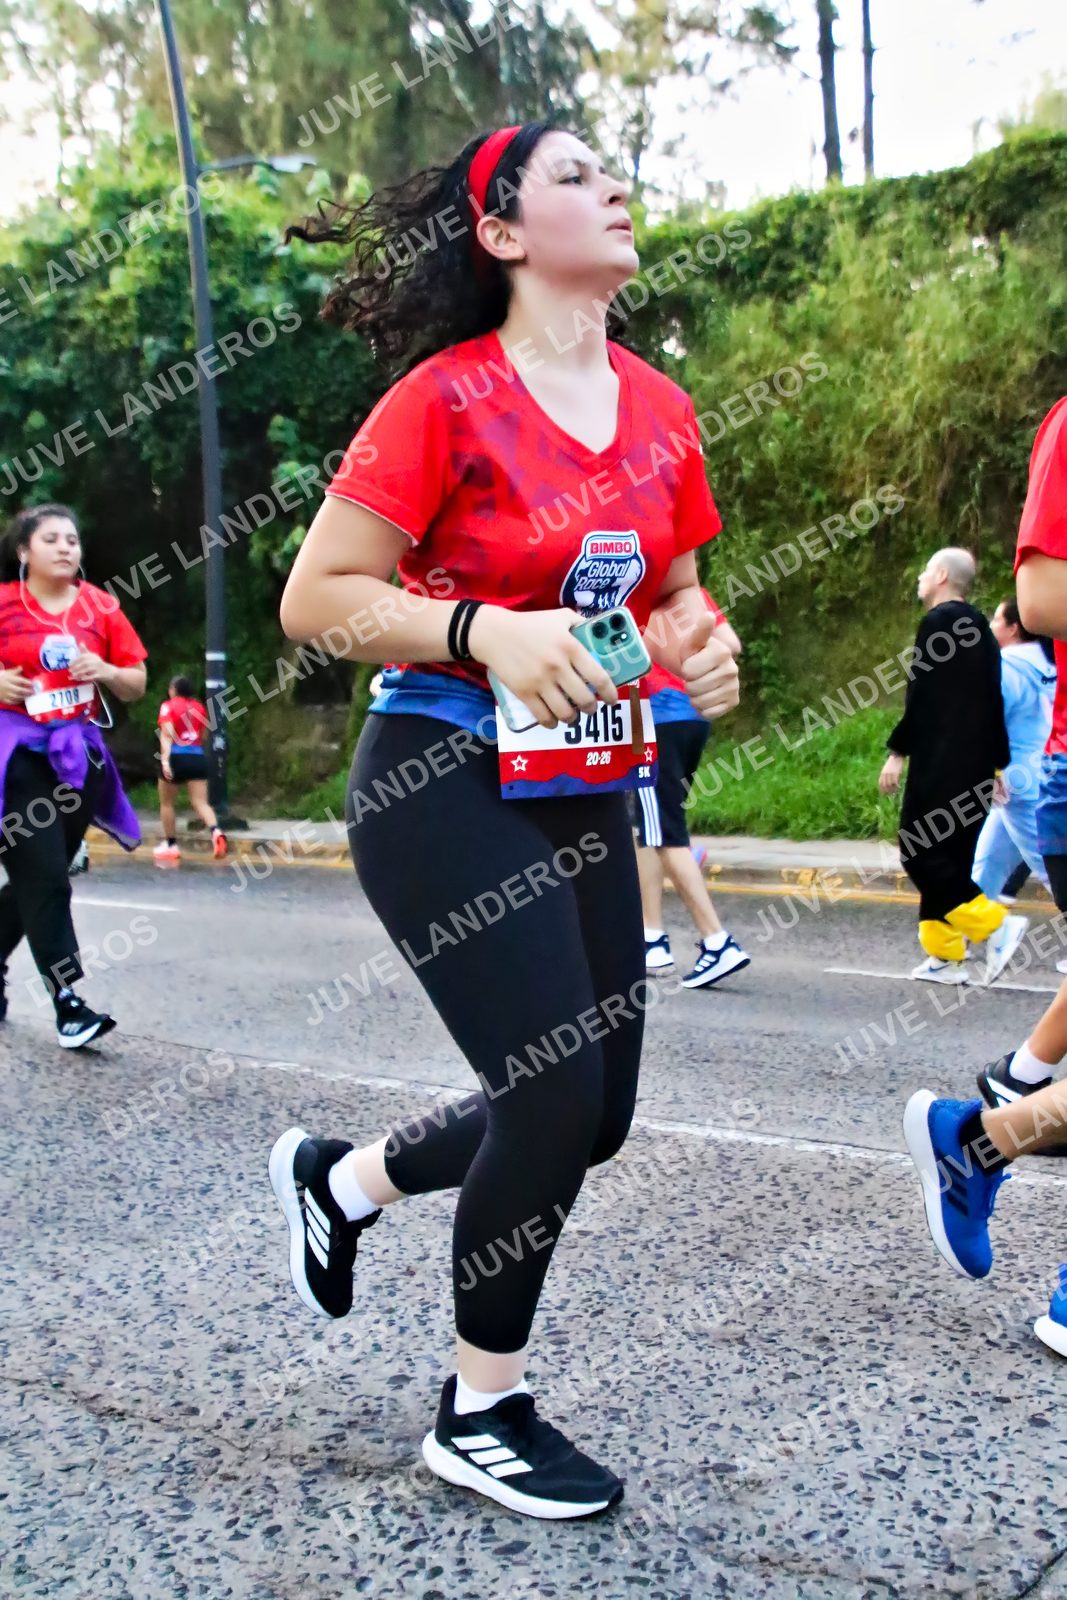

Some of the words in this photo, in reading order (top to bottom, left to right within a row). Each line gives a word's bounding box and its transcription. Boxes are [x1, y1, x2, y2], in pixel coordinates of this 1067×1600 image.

[590, 542, 632, 554] BIMBO
[588, 561, 628, 577] Global
[574, 577, 610, 590] Race
[564, 703, 623, 744] 3415
